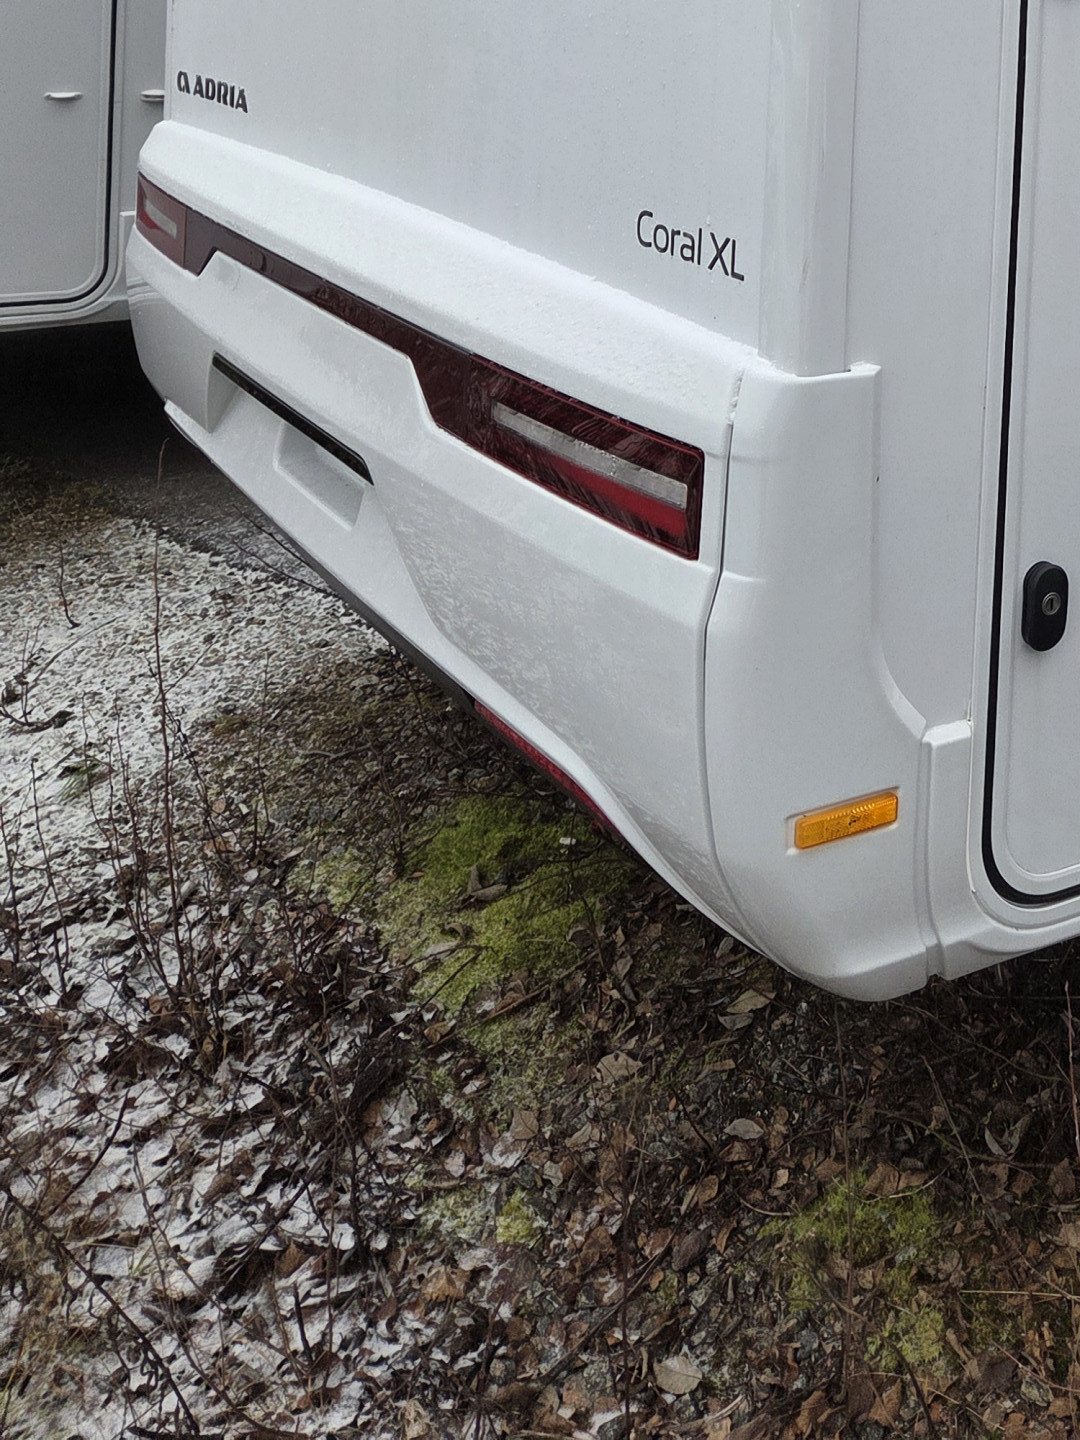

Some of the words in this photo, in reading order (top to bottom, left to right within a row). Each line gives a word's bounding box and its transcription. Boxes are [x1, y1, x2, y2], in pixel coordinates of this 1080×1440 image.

[193, 74, 248, 113] ADRIA
[637, 210, 702, 265] Coral
[708, 231, 744, 281] XL
